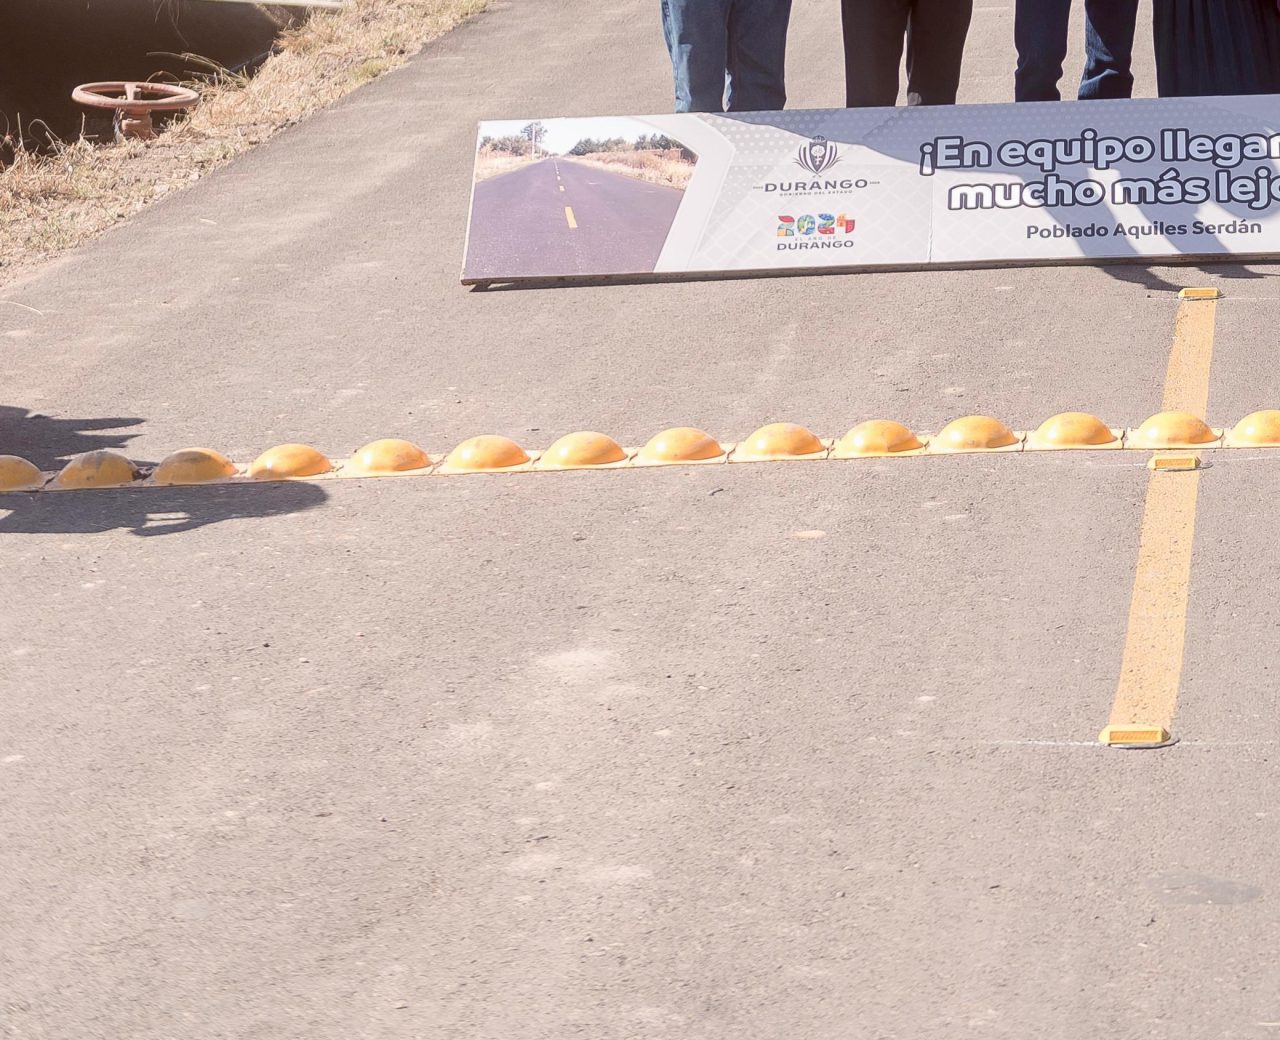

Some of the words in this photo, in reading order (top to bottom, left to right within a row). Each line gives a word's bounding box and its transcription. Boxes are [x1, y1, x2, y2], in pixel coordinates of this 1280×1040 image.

[920, 135, 992, 176] ¡En
[997, 128, 1155, 172] equipo
[764, 179, 868, 192] DURANGO
[948, 173, 1106, 210] mucho
[1111, 167, 1210, 205] más
[777, 213, 855, 237] 2024
[1026, 223, 1109, 239] Poblado
[1113, 221, 1187, 239] Aquiles
[1192, 218, 1262, 235] Serdán
[777, 240, 854, 251] DURANGO
